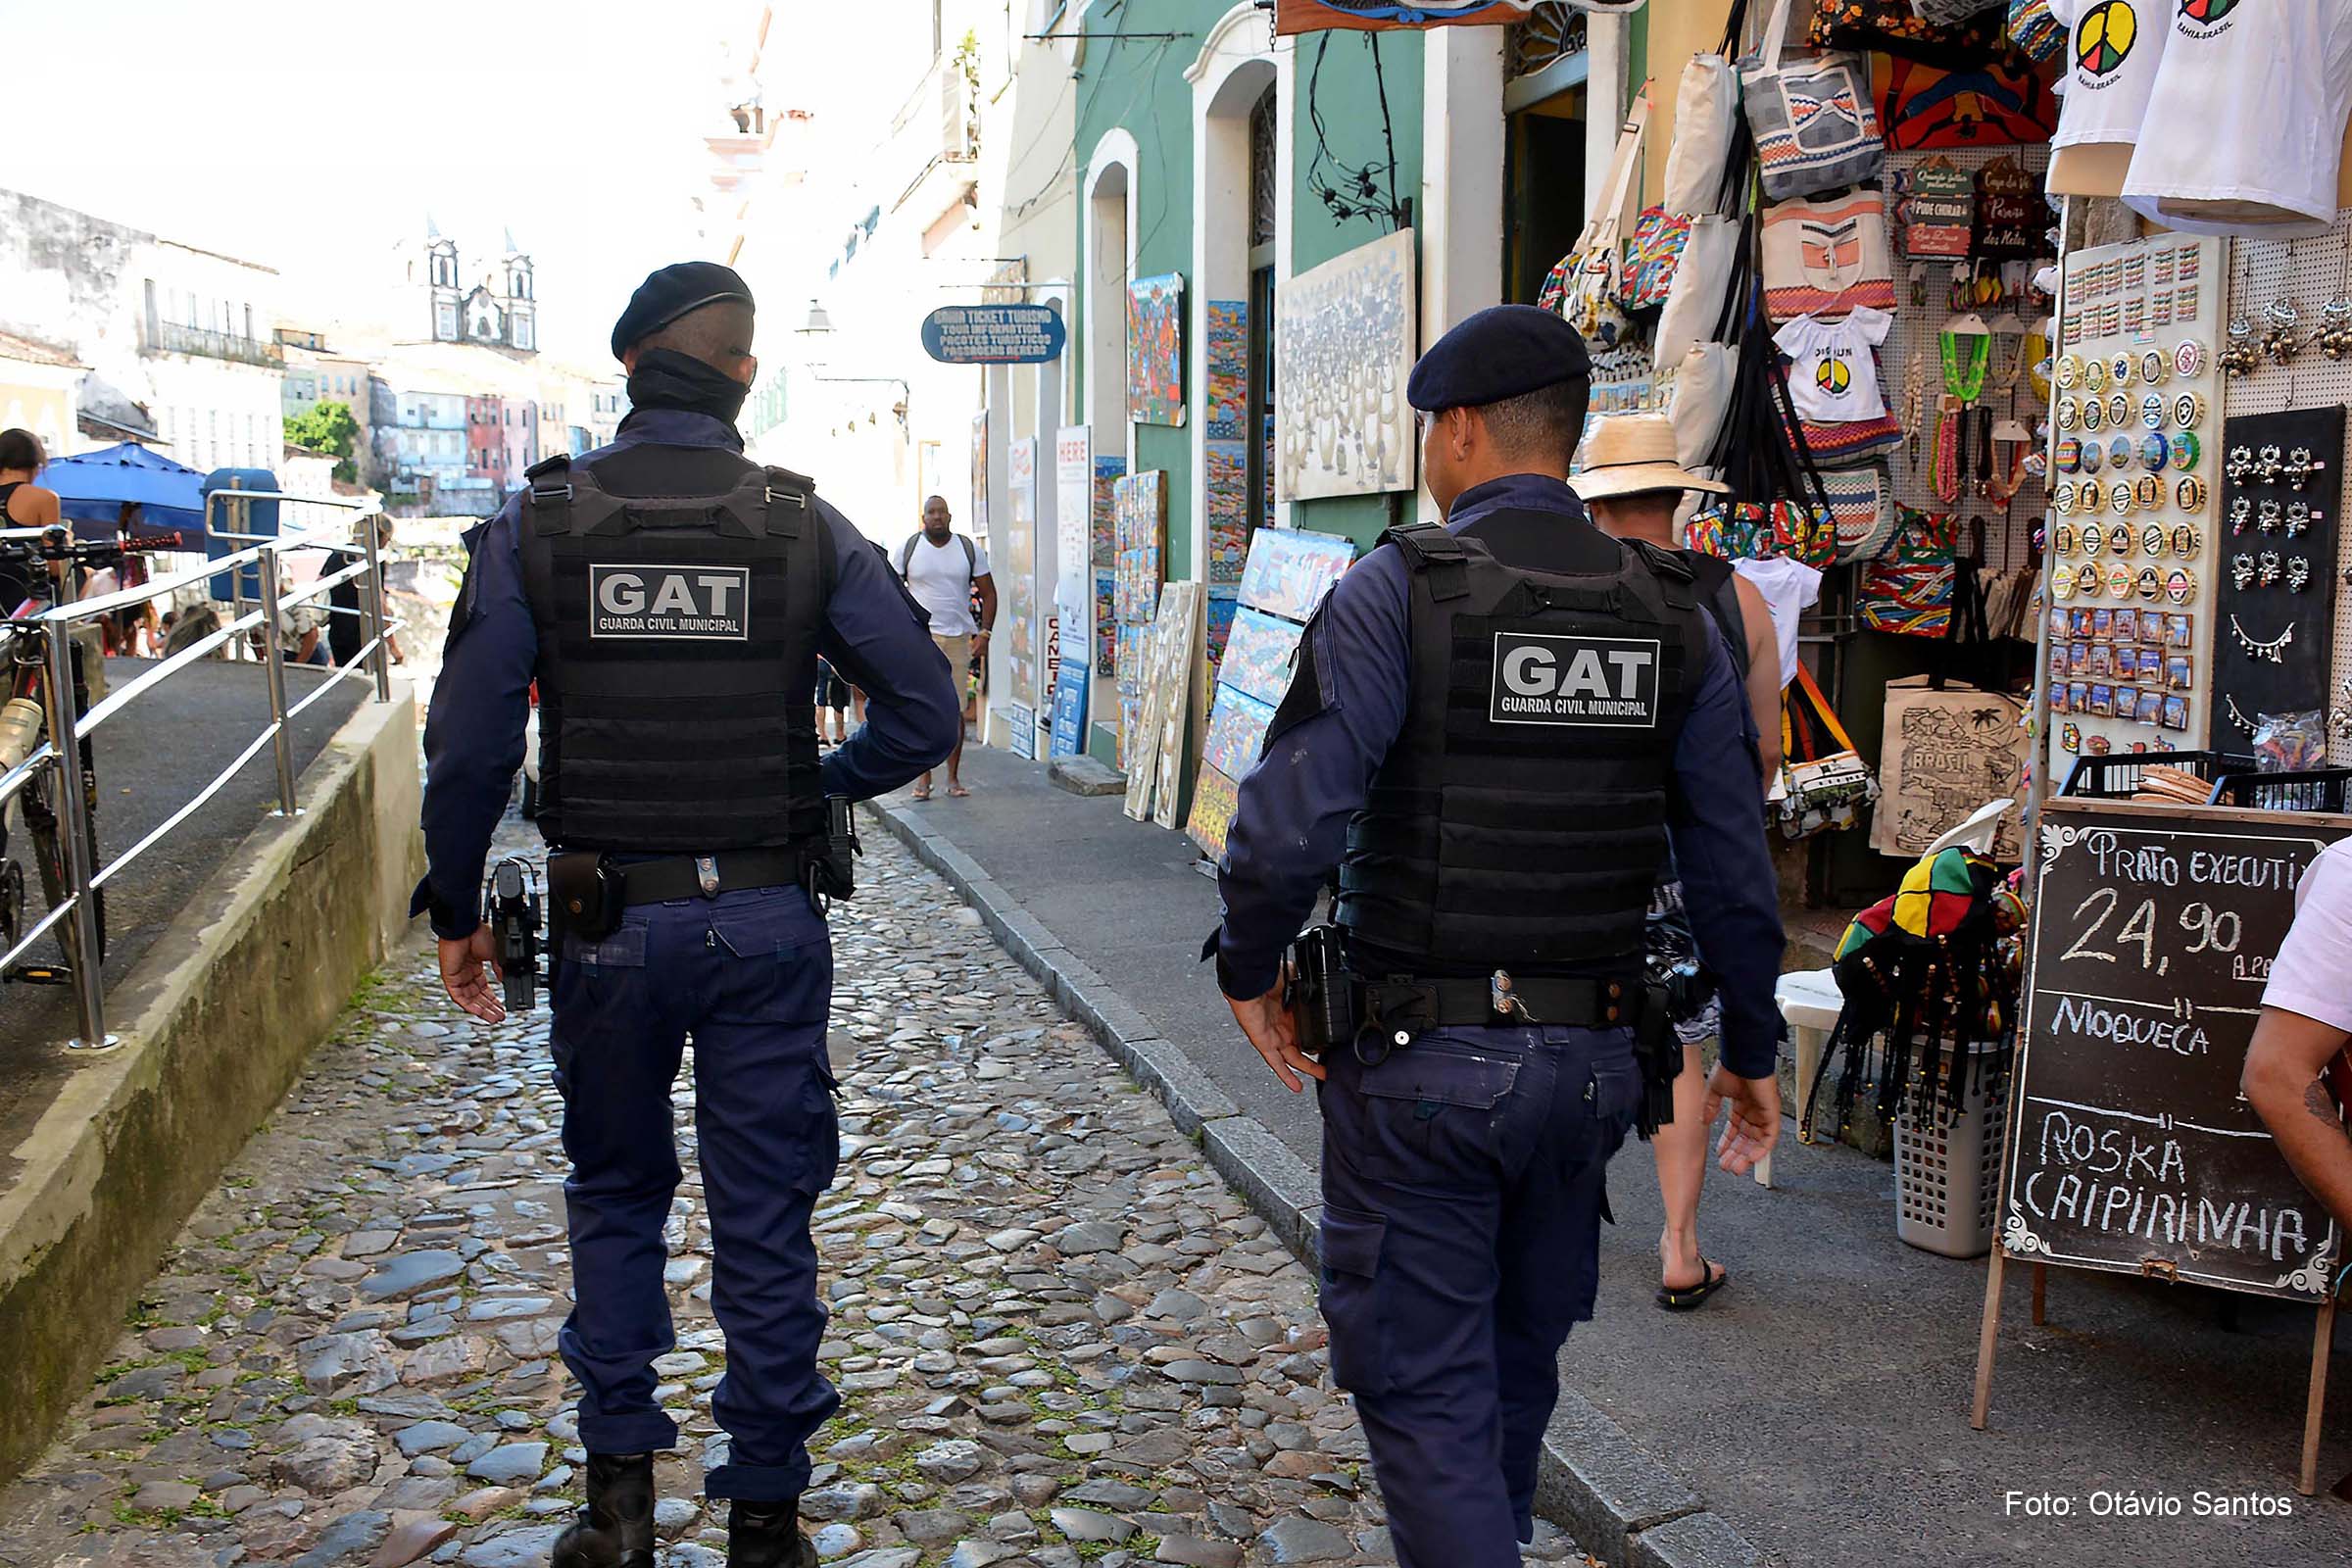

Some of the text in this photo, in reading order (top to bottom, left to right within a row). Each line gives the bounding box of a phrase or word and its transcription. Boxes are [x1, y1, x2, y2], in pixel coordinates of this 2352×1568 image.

[2177, 22, 2233, 39] BAHIA-BRASIL
[1916, 202, 1935, 216] PODE
[968, 310, 1005, 323] TICKET
[1008, 310, 1052, 323] TURISMO
[941, 325, 1041, 334] TOUR INFORMATION
[940, 334, 989, 345] PACOTES
[943, 345, 1004, 356] PASSAGENS
[1058, 440, 1087, 462] HERE
[599, 573, 741, 616] GAT
[599, 617, 740, 632] GUARDA CIVIL MUNICIPAL
[1502, 646, 1652, 699] GAT
[1501, 697, 1647, 716] GUARDA CIVIL MUNICIPAL
[2189, 851, 2305, 891] EXECUTI
[2051, 996, 2211, 1055] MOQUECA
[2040, 1110, 2185, 1183] ROSKA
[2025, 1171, 2307, 1261] CAIPIRINHA
